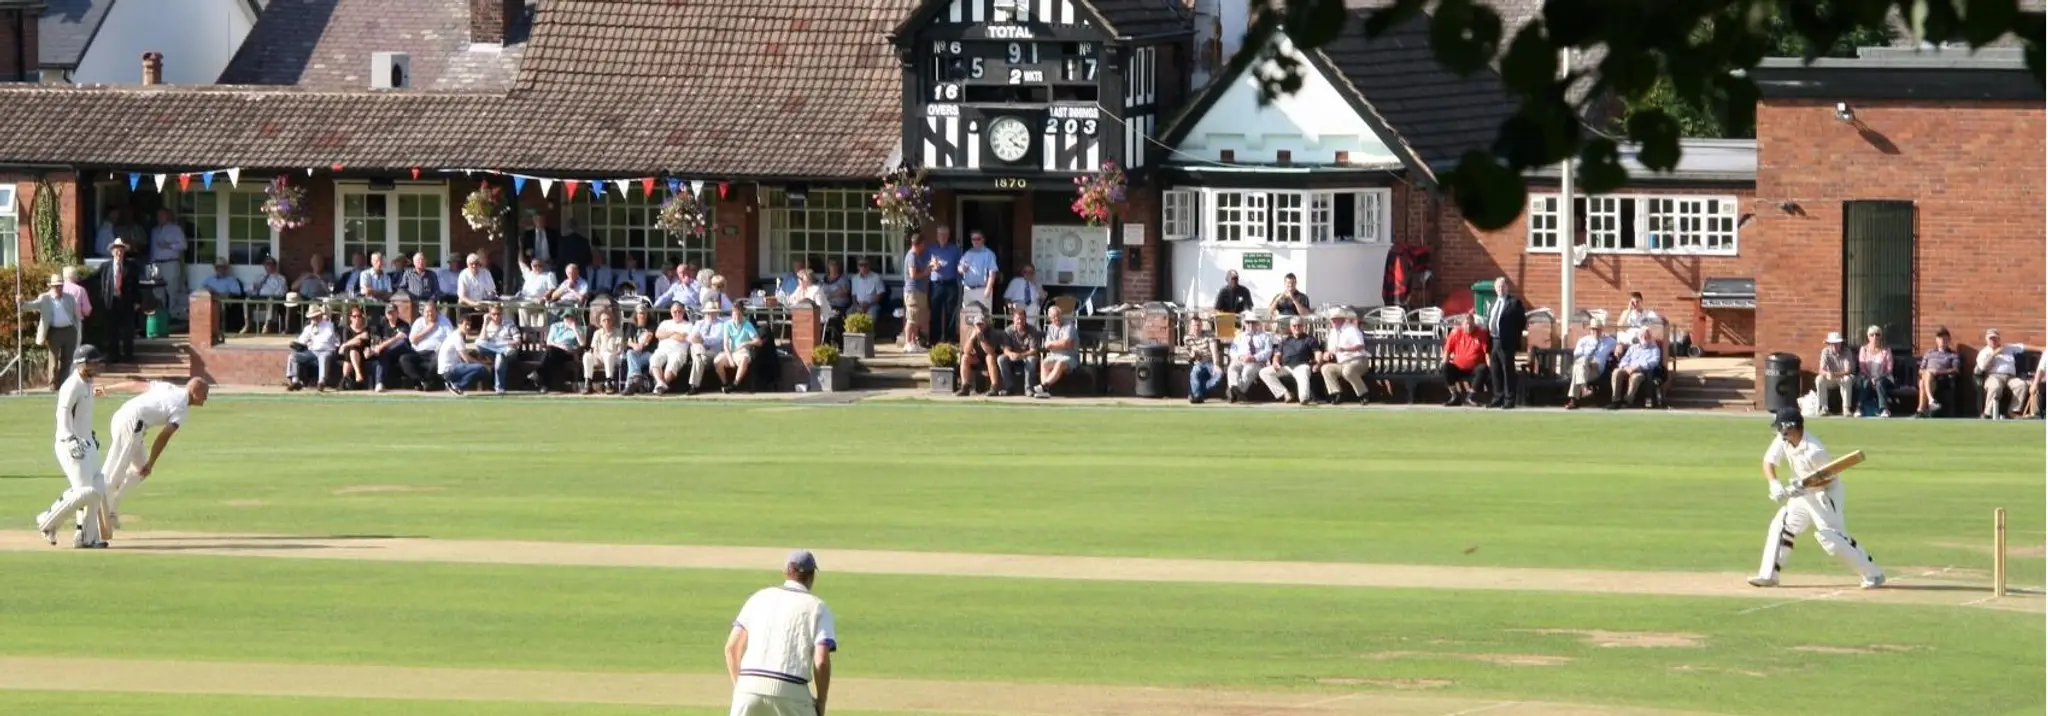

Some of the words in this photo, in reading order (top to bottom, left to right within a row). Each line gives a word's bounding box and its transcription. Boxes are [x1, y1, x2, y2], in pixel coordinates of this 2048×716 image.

[987, 25, 1033, 38] TOTAL
[950, 41, 961, 54] 6
[1009, 69, 1022, 84] 2
[934, 84, 959, 100] 16
[927, 104, 959, 115] OVERS
[1049, 107, 1068, 118] LAST
[1068, 107, 1099, 119] INNINGS
[995, 178, 1026, 188] 1870
